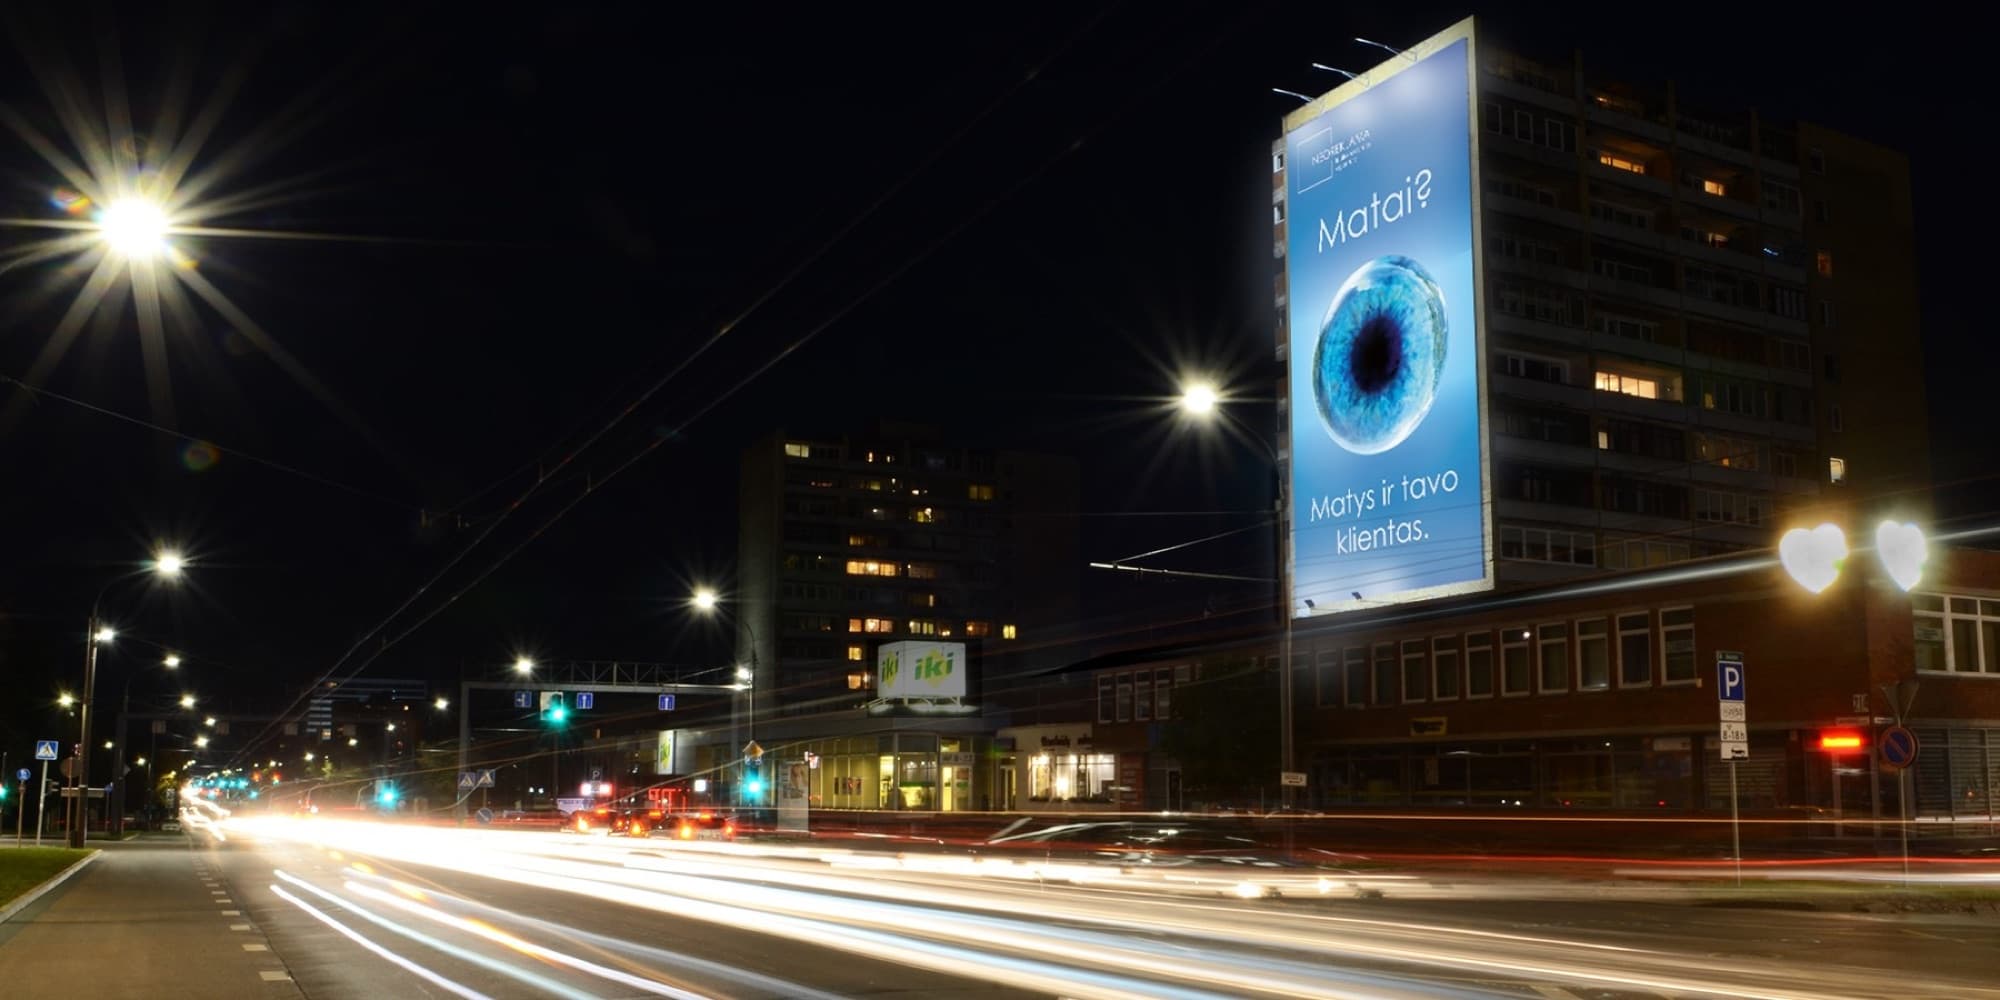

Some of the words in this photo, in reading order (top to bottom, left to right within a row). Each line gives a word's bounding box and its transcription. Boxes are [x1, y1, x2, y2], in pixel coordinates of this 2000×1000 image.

[1318, 168, 1432, 254] Matai?
[1310, 487, 1375, 523] Matys
[1381, 479, 1395, 507] ir
[1401, 469, 1459, 502] tavo
[1336, 518, 1430, 556] klientas.
[881, 651, 899, 683] iki
[914, 652, 955, 681] iki
[1724, 667, 1740, 698] P
